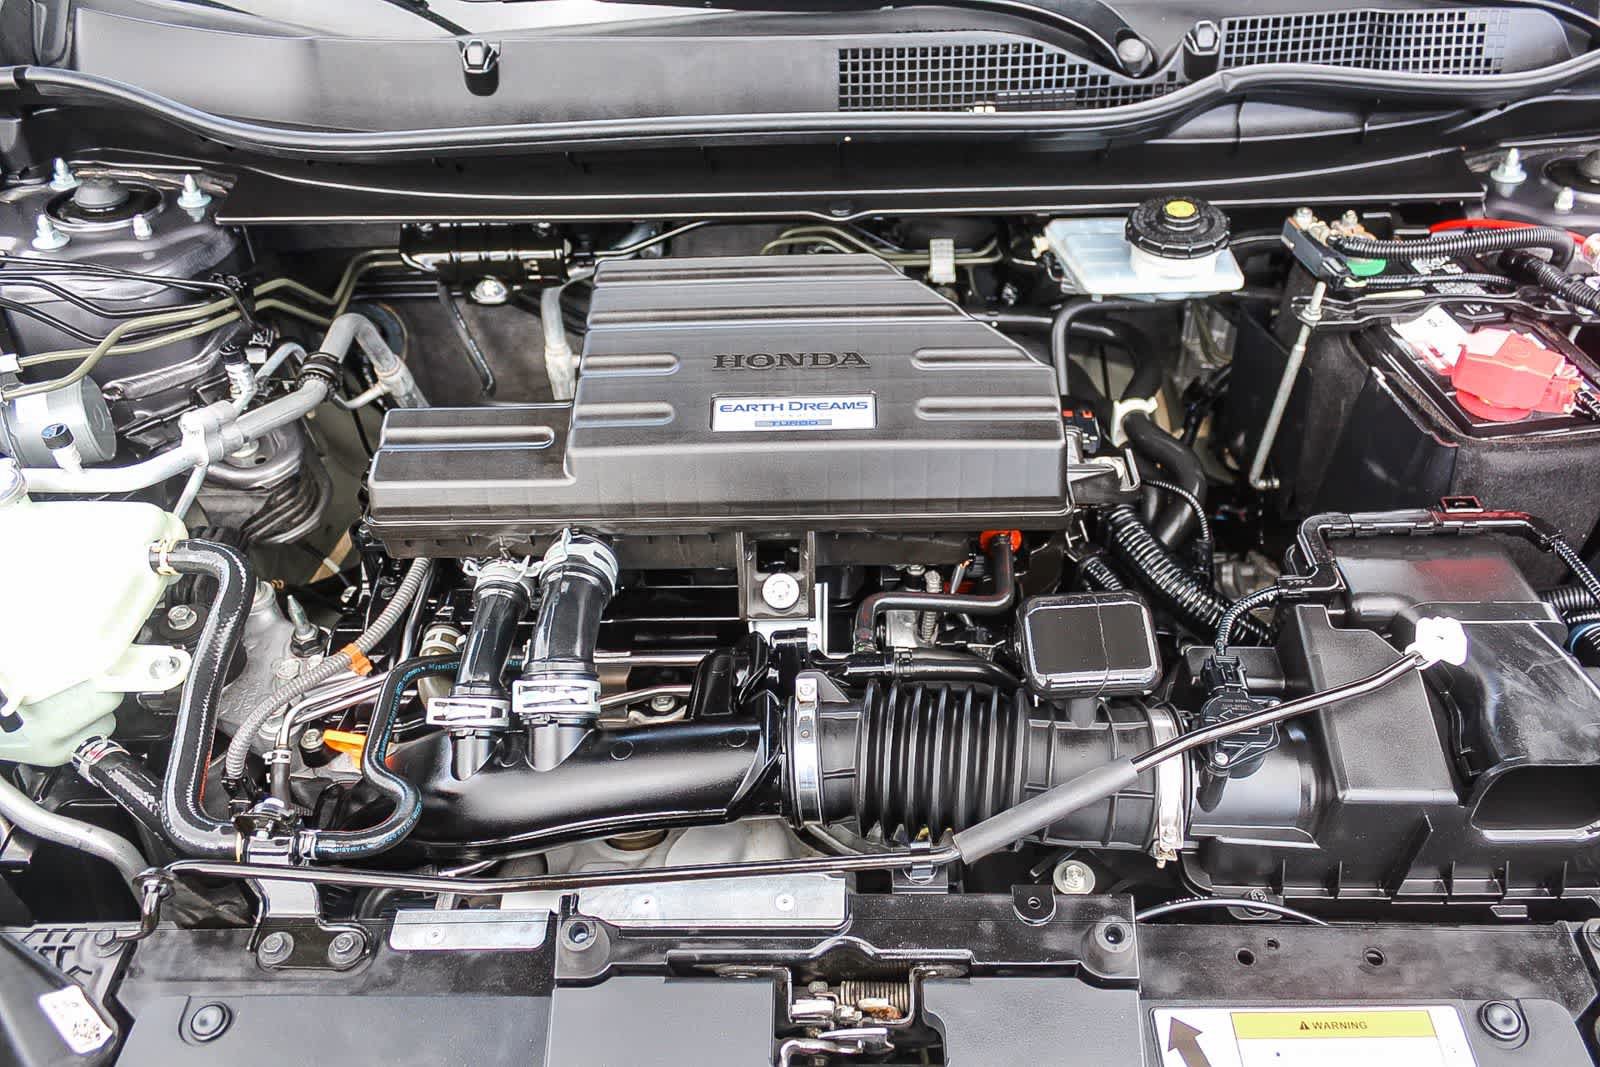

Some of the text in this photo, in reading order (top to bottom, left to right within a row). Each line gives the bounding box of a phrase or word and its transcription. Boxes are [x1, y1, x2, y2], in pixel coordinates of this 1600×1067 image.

[712, 352, 870, 369] HONDA
[719, 401, 868, 413] EARTH DREAMS
[1312, 1021, 1367, 1030] WARNING
